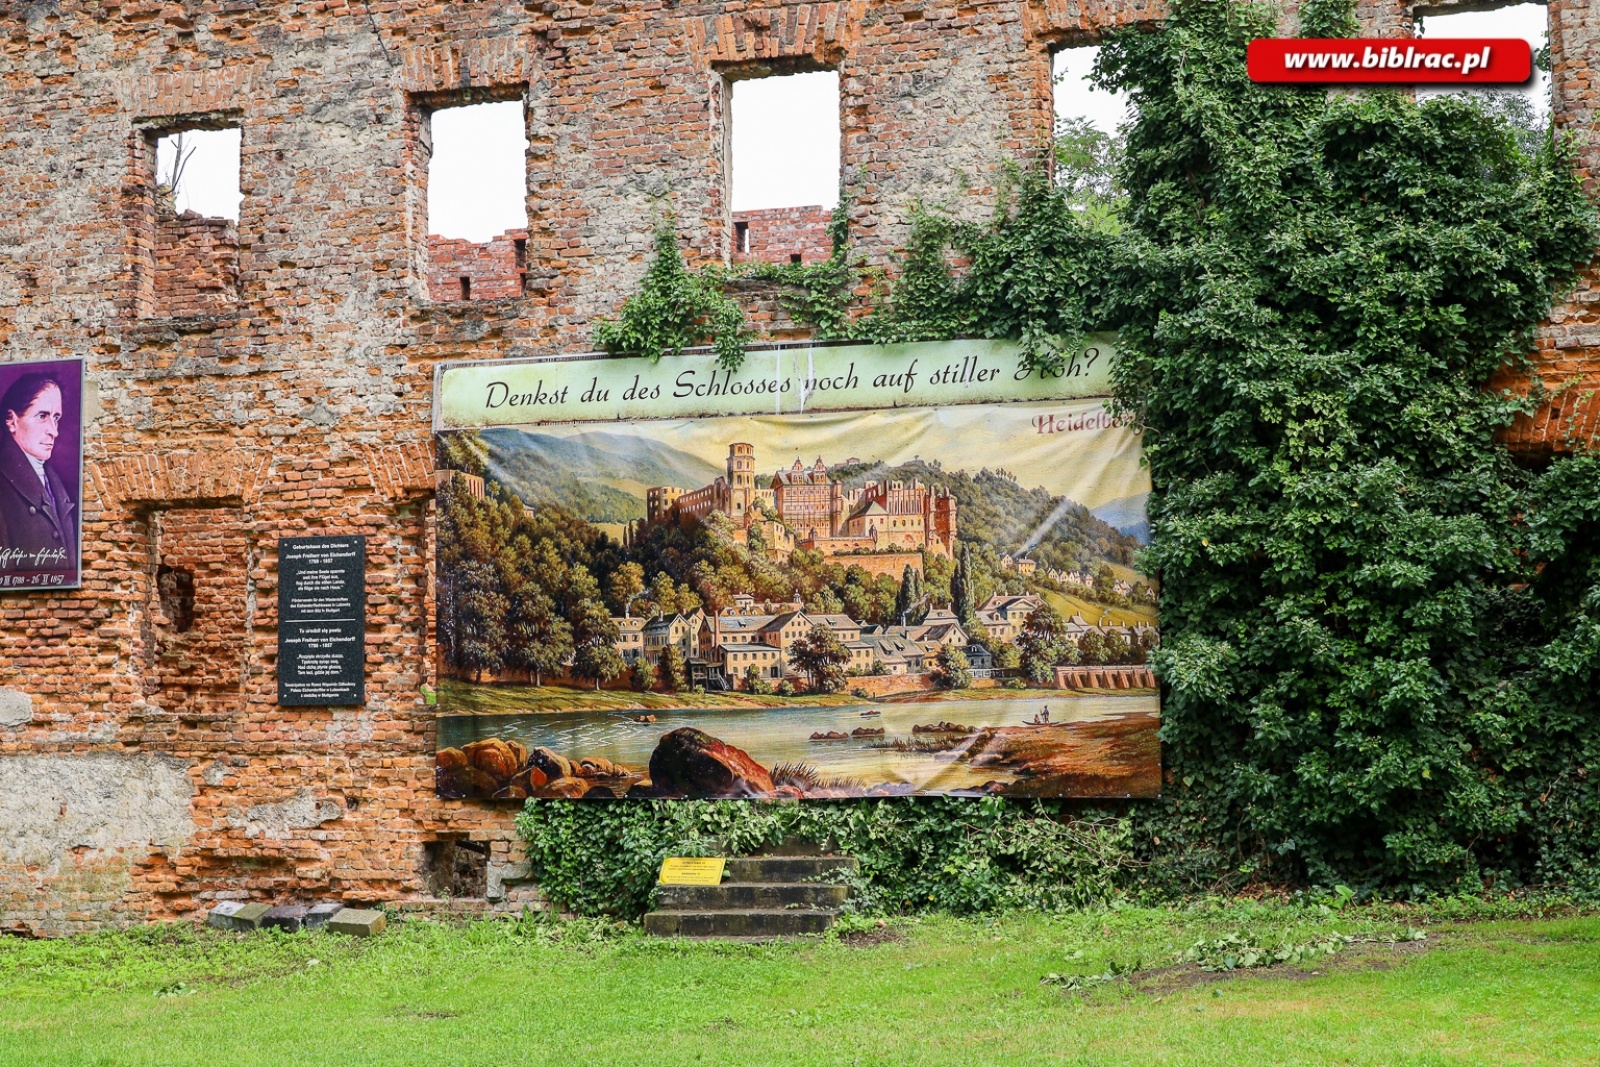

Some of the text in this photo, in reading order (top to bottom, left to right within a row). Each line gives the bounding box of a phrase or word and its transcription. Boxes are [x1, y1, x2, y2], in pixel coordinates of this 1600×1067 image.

[484, 379, 569, 408] Denkst
[580, 376, 609, 403] du
[622, 374, 661, 400] des
[672, 369, 792, 398] Schlosses
[803, 362, 859, 391] noch
[872, 358, 919, 394] auf
[929, 355, 1001, 385] stiller
